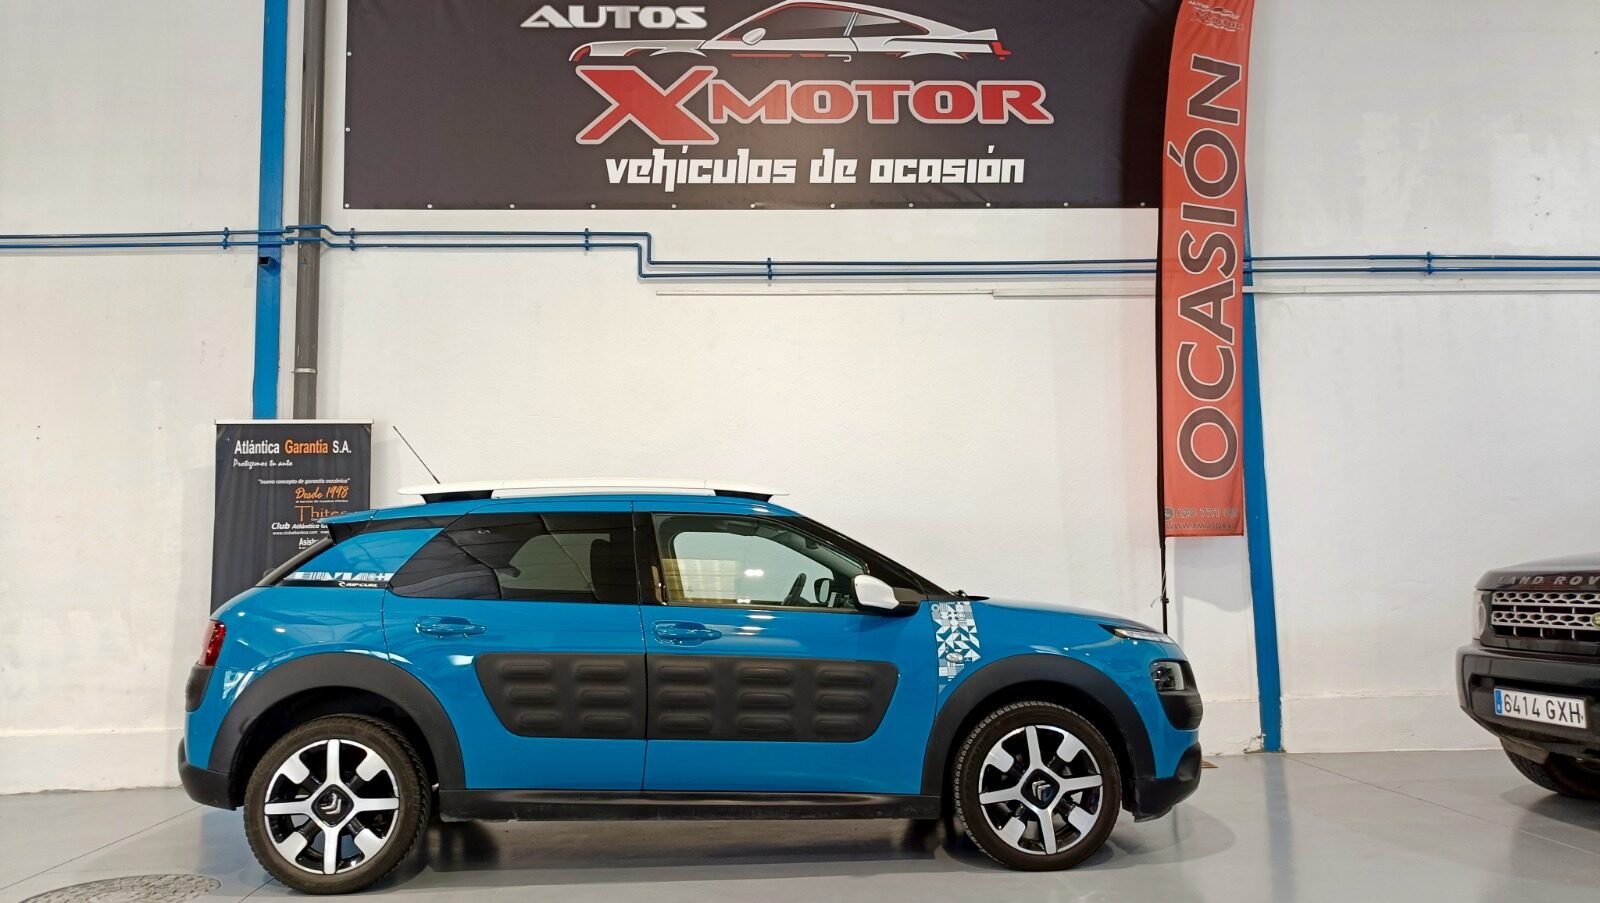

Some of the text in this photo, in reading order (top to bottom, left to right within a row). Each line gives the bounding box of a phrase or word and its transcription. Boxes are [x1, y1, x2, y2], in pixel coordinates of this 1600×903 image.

[520, 5, 707, 29] AUTOS
[575, 65, 1055, 145] XMOTOR
[605, 145, 1025, 192] vehículos de ocasión
[1167, 52, 1242, 481] OCASIÓN
[234, 438, 352, 455] Atlántica Garantía S.A.
[295, 486, 349, 499] Desde 1998
[271, 522, 291, 530] Club
[1498, 575, 1600, 586] LAND ROV
[1503, 694, 1581, 724] 6414 GXH
